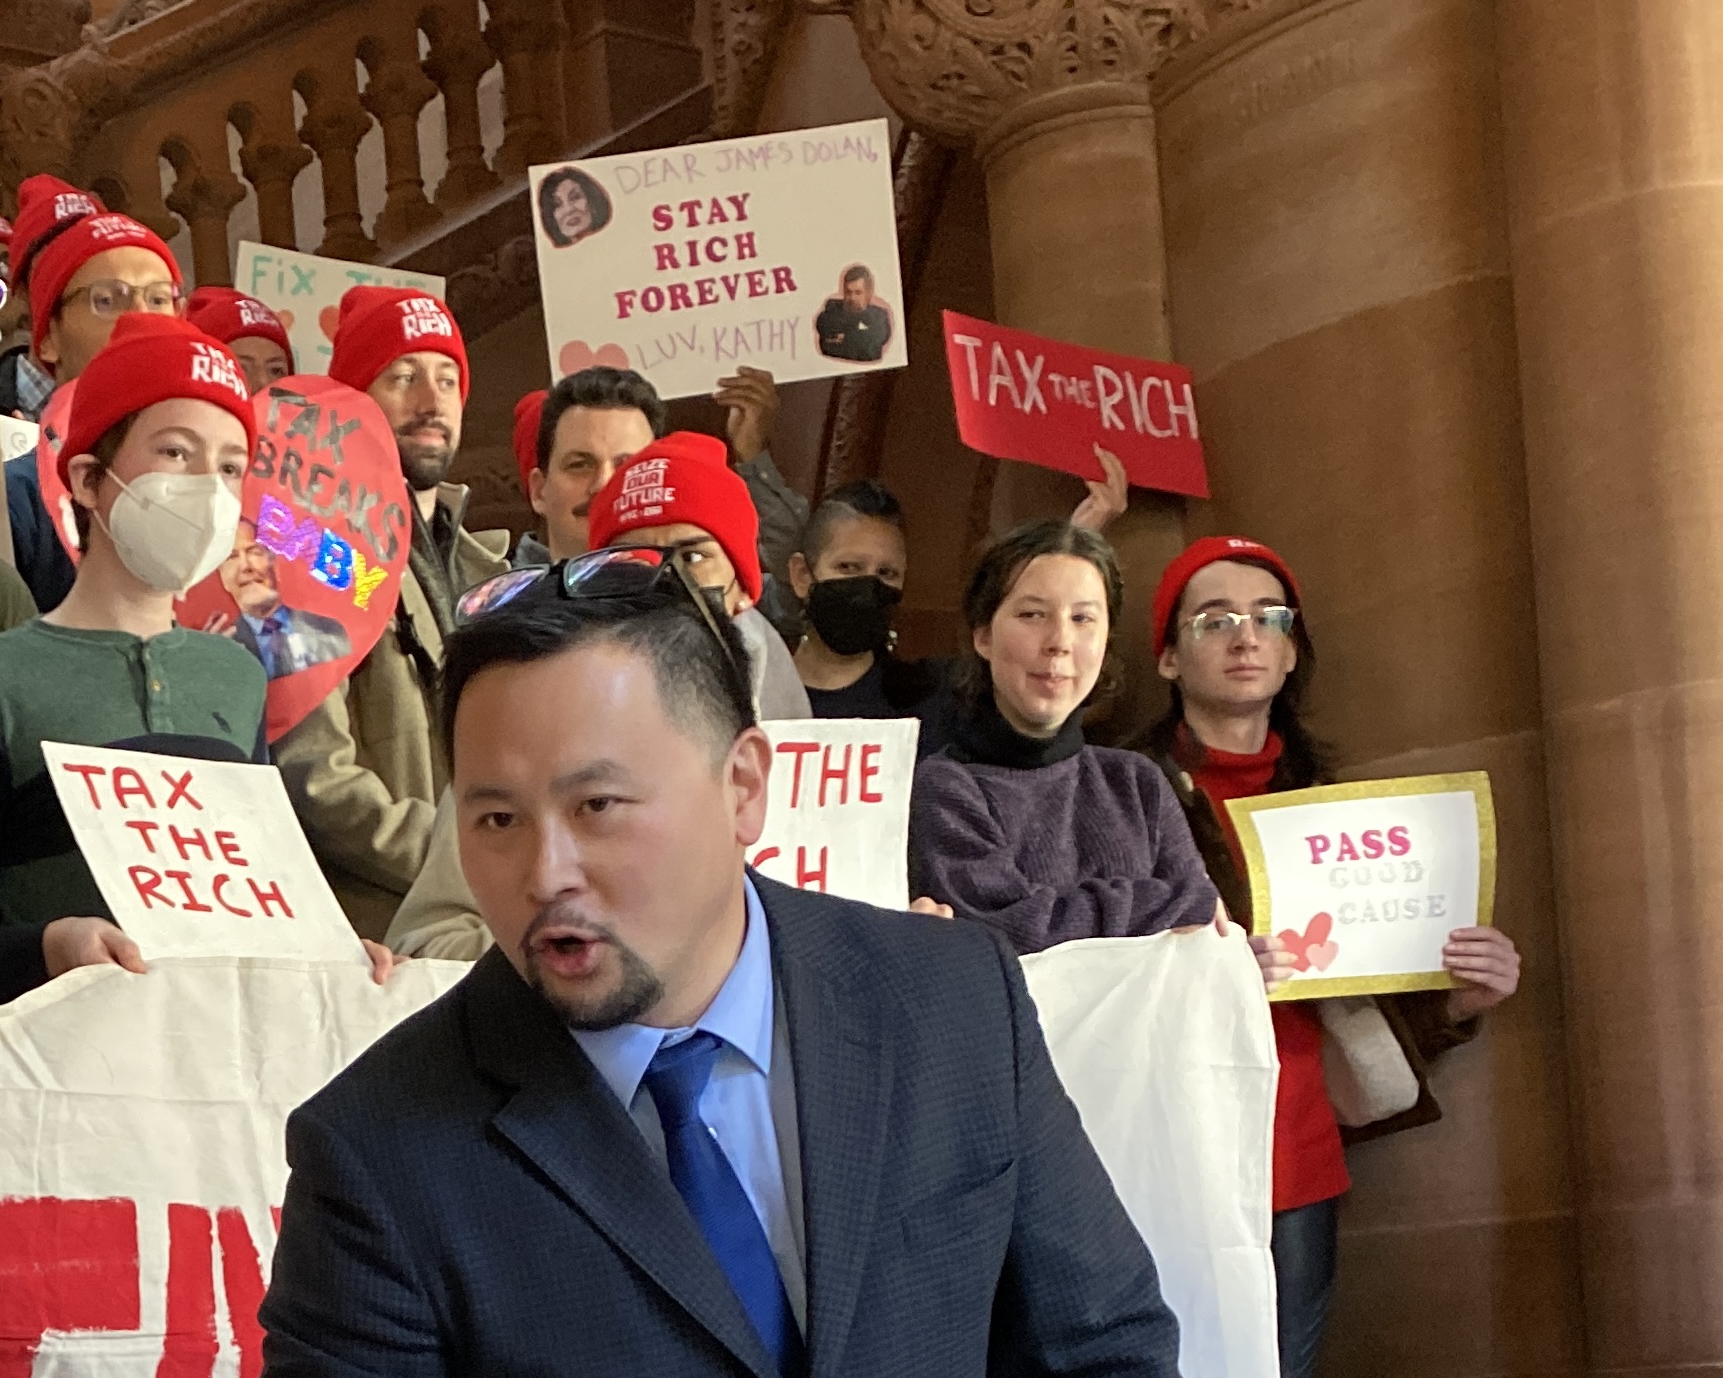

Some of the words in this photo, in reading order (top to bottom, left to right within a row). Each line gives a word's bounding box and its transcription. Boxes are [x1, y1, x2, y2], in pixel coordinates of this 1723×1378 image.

[614, 153, 706, 195] DEAR
[715, 141, 794, 173] JAMES
[651, 192, 751, 232] STAY
[653, 231, 759, 272] RICH
[395, 297, 443, 315] TAX
[613, 265, 798, 320] FOREVER
[401, 311, 453, 341] RICH
[712, 316, 800, 363] KATHY
[191, 354, 248, 402] RICH
[952, 333, 1048, 415] TAX
[1047, 372, 1097, 409] THE
[1093, 364, 1199, 440] RICH
[268, 387, 361, 466] TAX
[251, 434, 405, 562] BREAKS
[255, 493, 388, 612] BABY
[63, 762, 204, 811] TAX
[776, 742, 883, 808] THE
[126, 821, 248, 867] THE
[1305, 826, 1412, 865] PASS
[127, 864, 296, 920] RICH
[1337, 894, 1447, 925] CAUSE
